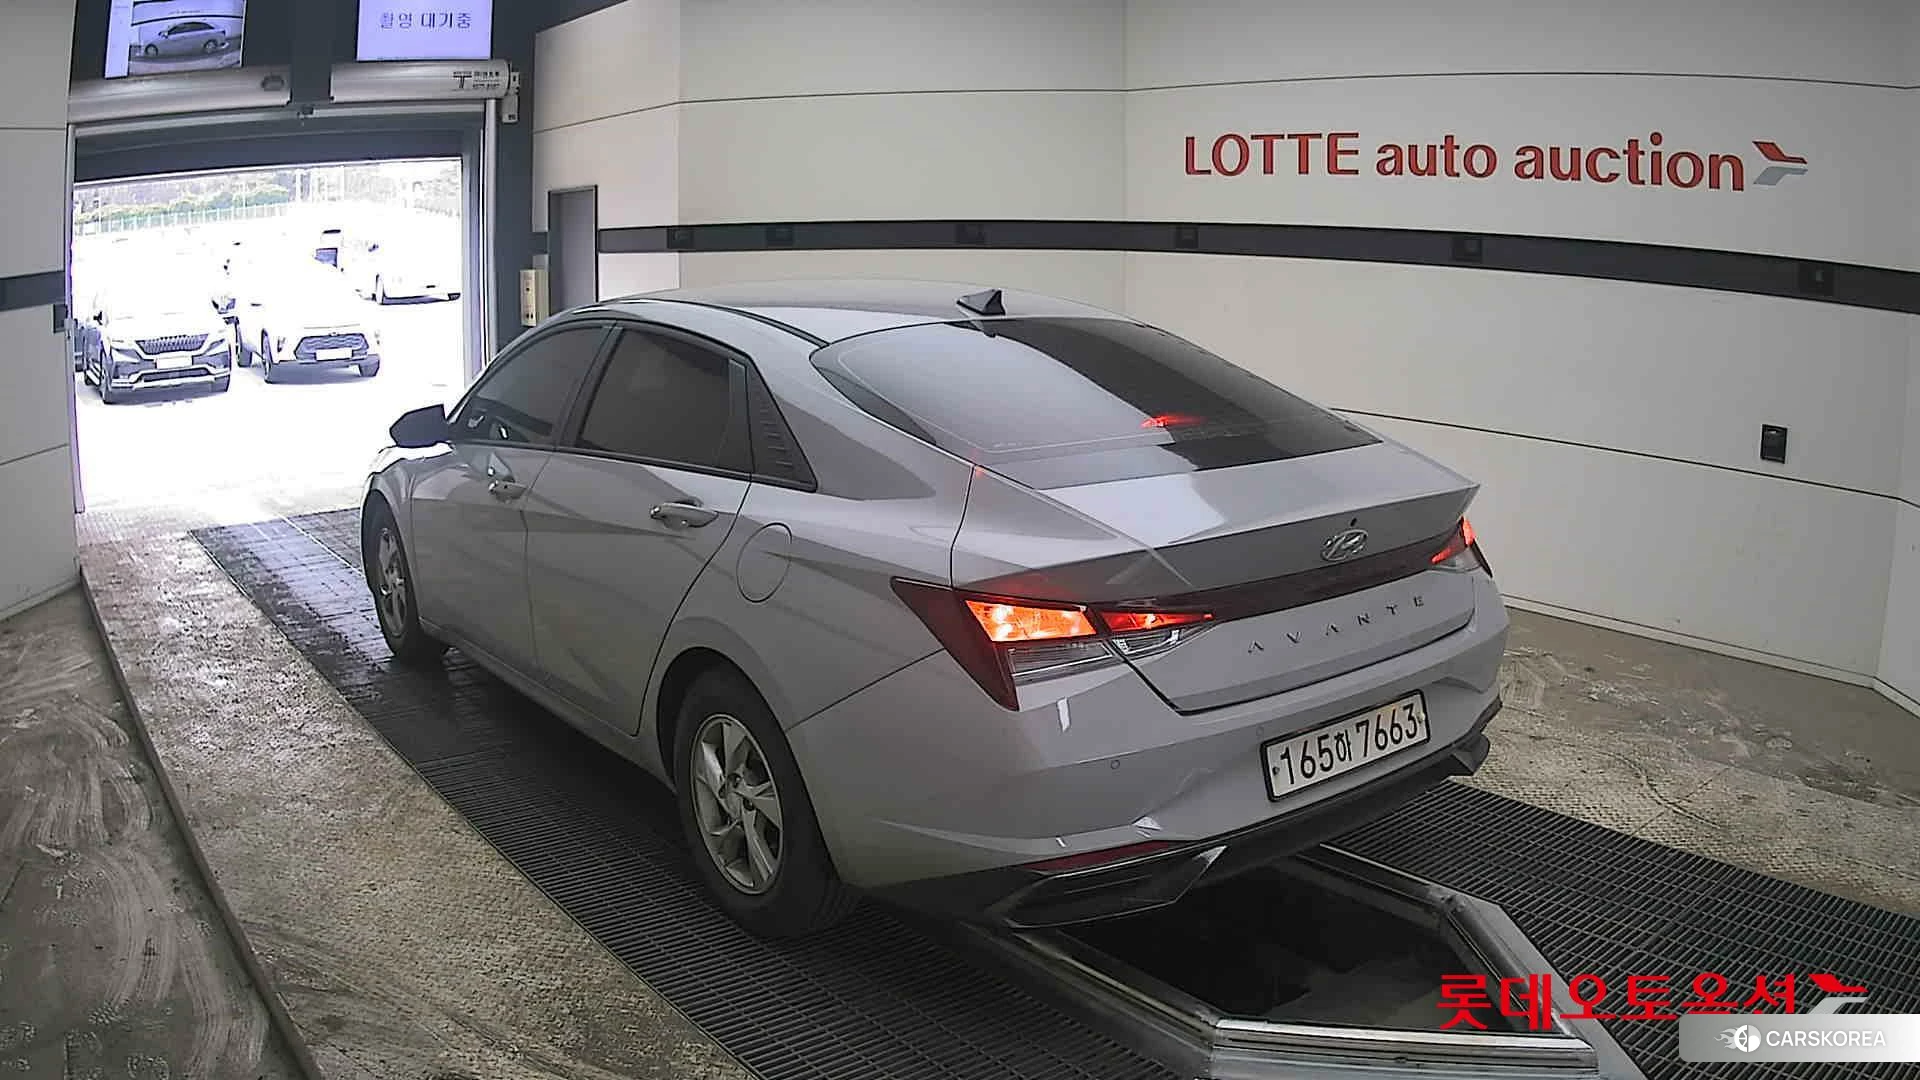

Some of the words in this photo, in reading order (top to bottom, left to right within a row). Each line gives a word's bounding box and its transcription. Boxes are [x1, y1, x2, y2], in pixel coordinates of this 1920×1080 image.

[1184, 132, 1360, 176] LOTTE
[1375, 134, 1498, 178] auto
[1513, 132, 1745, 192] auction
[1248, 595, 1425, 654] AVANTE
